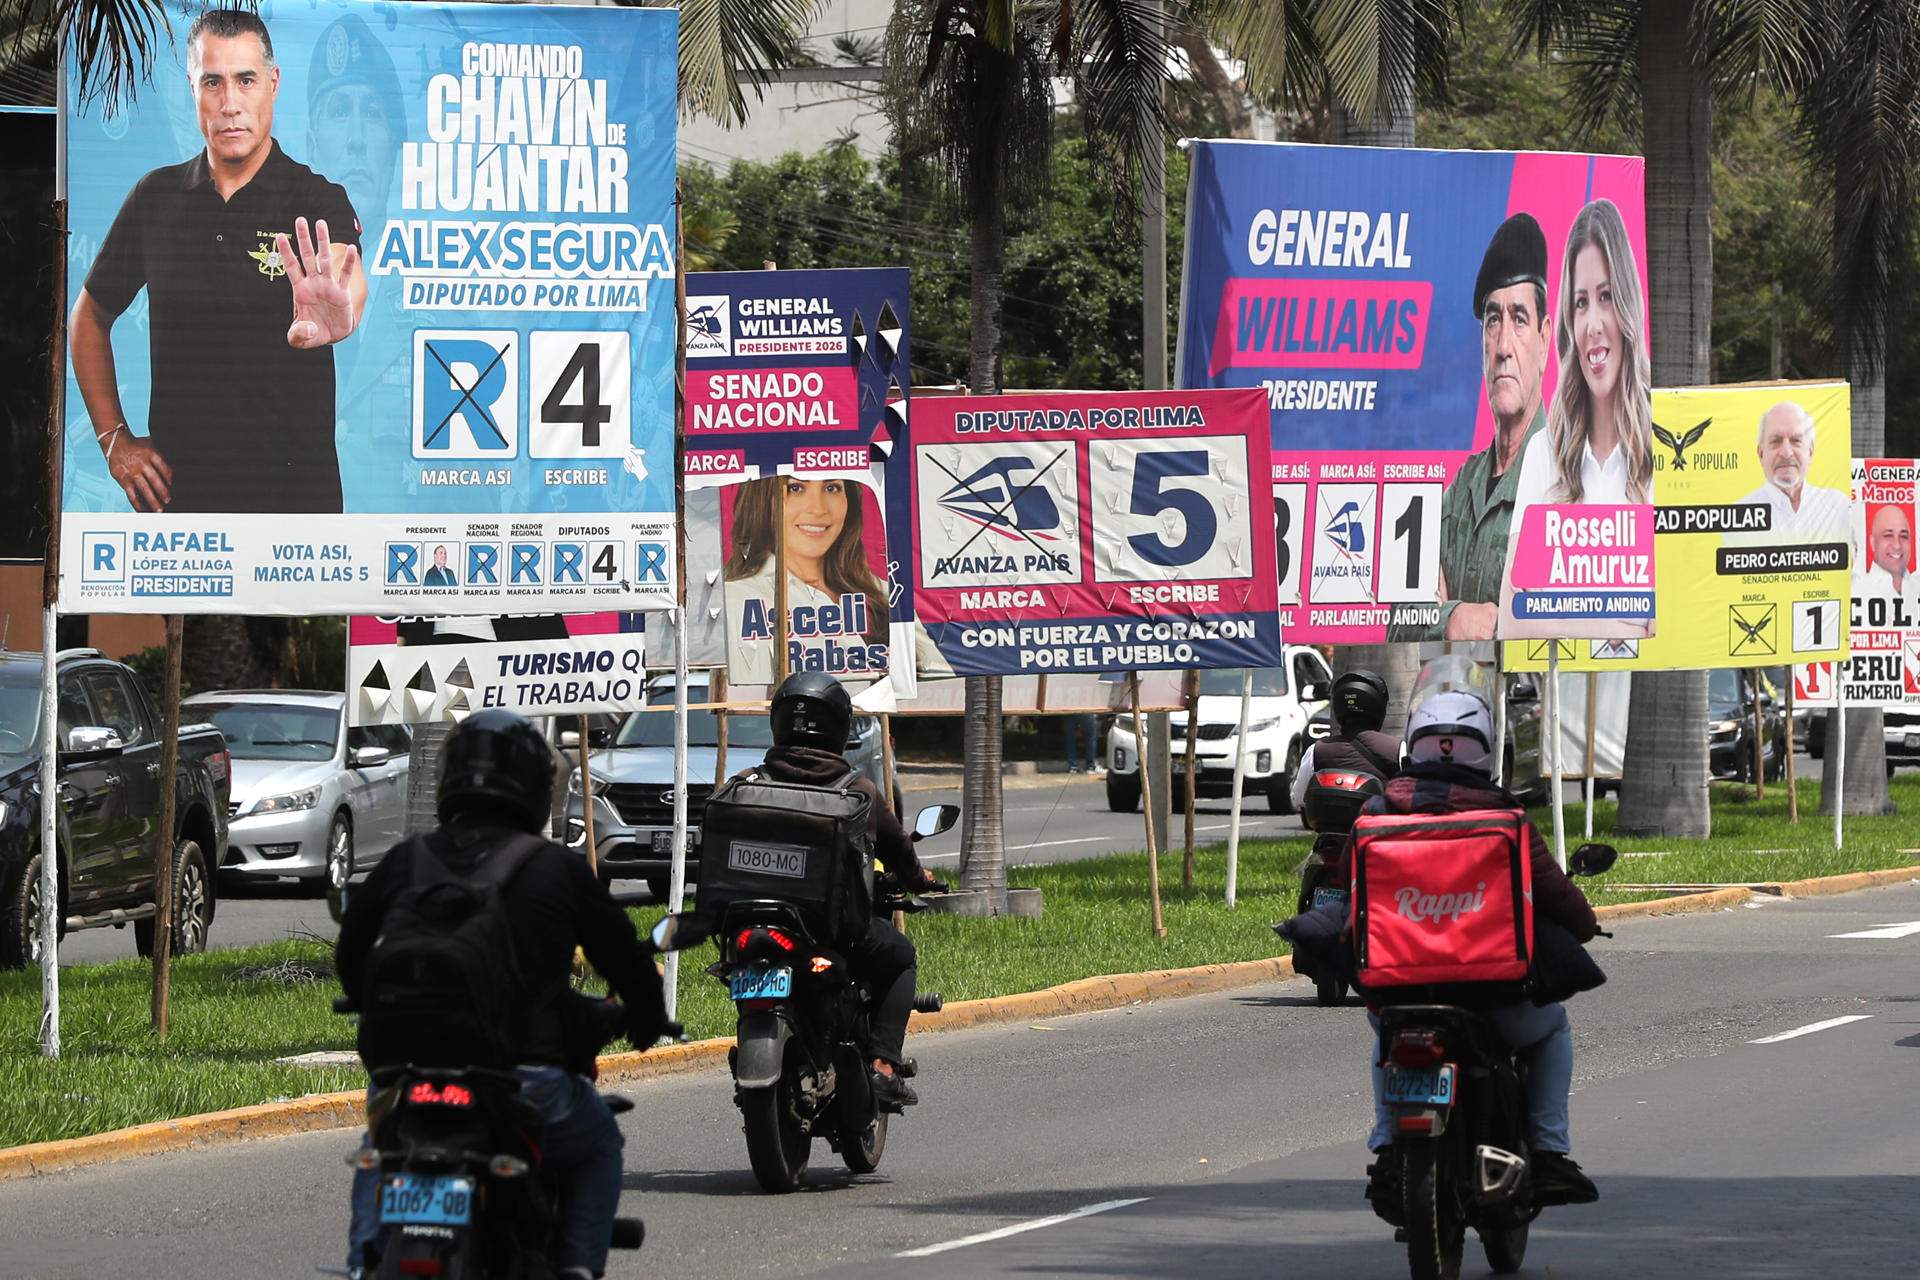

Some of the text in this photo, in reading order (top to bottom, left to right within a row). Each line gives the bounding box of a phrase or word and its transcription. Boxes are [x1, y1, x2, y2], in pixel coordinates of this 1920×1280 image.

[462, 42, 583, 79] COMANDO
[427, 74, 627, 146] CHAVÍN DE
[402, 142, 629, 214] HUÁNTAR
[377, 225, 671, 274] ALEX SEGURA
[1248, 208, 1412, 269] GENERAL
[410, 282, 641, 308] DIPUTADO POR LIMA
[738, 297, 834, 316] GENERAL
[739, 317, 843, 337] WILLIAMS
[1236, 295, 1419, 354] WILLIAMS
[739, 341, 843, 353] PRESIDENTE 2026
[424, 340, 506, 449] R
[541, 343, 611, 447] 4
[709, 372, 824, 400] SENADO
[1262, 379, 1378, 410] PRESIDENTE
[693, 401, 840, 429] NACIONAL
[955, 406, 1205, 433] DIPUTADA POR LIMA
[797, 450, 867, 468] ESCRIBE
[1290, 462, 1310, 478] ASÍ:
[1320, 462, 1377, 478] MARCA ASÍ:
[1383, 462, 1446, 478] ESCRIBE ASÍ:
[1693, 452, 1738, 471] POPULAR
[421, 470, 511, 485] MARCA ASI
[545, 470, 607, 485] ESCRIBE
[1862, 486, 1915, 501] Manos
[1127, 450, 1218, 568] 5
[1685, 507, 1767, 530] POPULAR
[558, 526, 610, 536] DIPUTADOS
[1545, 510, 1636, 548] Rosselli
[133, 532, 234, 552] RAFAEL
[272, 544, 352, 562] VOTA ASI,
[1395, 496, 1423, 589] 1
[94, 543, 115, 571] R
[132, 557, 233, 571] LÓPEZ ALIAGA
[388, 544, 419, 584] R
[467, 544, 499, 584] R
[510, 544, 542, 583] R
[553, 543, 584, 583] R
[592, 544, 617, 581] 4
[638, 543, 667, 582] R
[933, 552, 1070, 575] AVANZA PAÍS
[1549, 547, 1650, 584] Amuruz
[1725, 550, 1839, 569] PEDRO CATERIANO
[254, 566, 369, 582] MARCA LAS 5
[1314, 563, 1370, 577] AVANZA PAÍS
[1742, 572, 1822, 584] SENADOR NACIONAL
[134, 577, 232, 594] PRESIDENTE
[1130, 585, 1220, 605] ESCRIBE
[1803, 590, 1830, 599] ESCRIBE
[960, 590, 1046, 610] MARCA
[1526, 597, 1650, 613] PARLAMENTO ANDINO
[1742, 594, 1767, 602] MARCA
[1310, 609, 1390, 626] PARLAMENTO
[1393, 609, 1440, 626] ANDINO
[1807, 605, 1822, 645] 1
[961, 620, 1256, 648] CON FUERZA Y CORAZON
[1851, 633, 1869, 648] POR
[1872, 633, 1900, 648] LIMA
[498, 650, 615, 677] TURISMO
[1020, 643, 1200, 668] POR EL PUEBLO.
[482, 686, 507, 708] EL
[516, 679, 631, 706] TRABAJO
[1845, 684, 1903, 700] RIMERO
[737, 849, 799, 872] 1080-MC
[1394, 881, 1488, 924] Rappi
